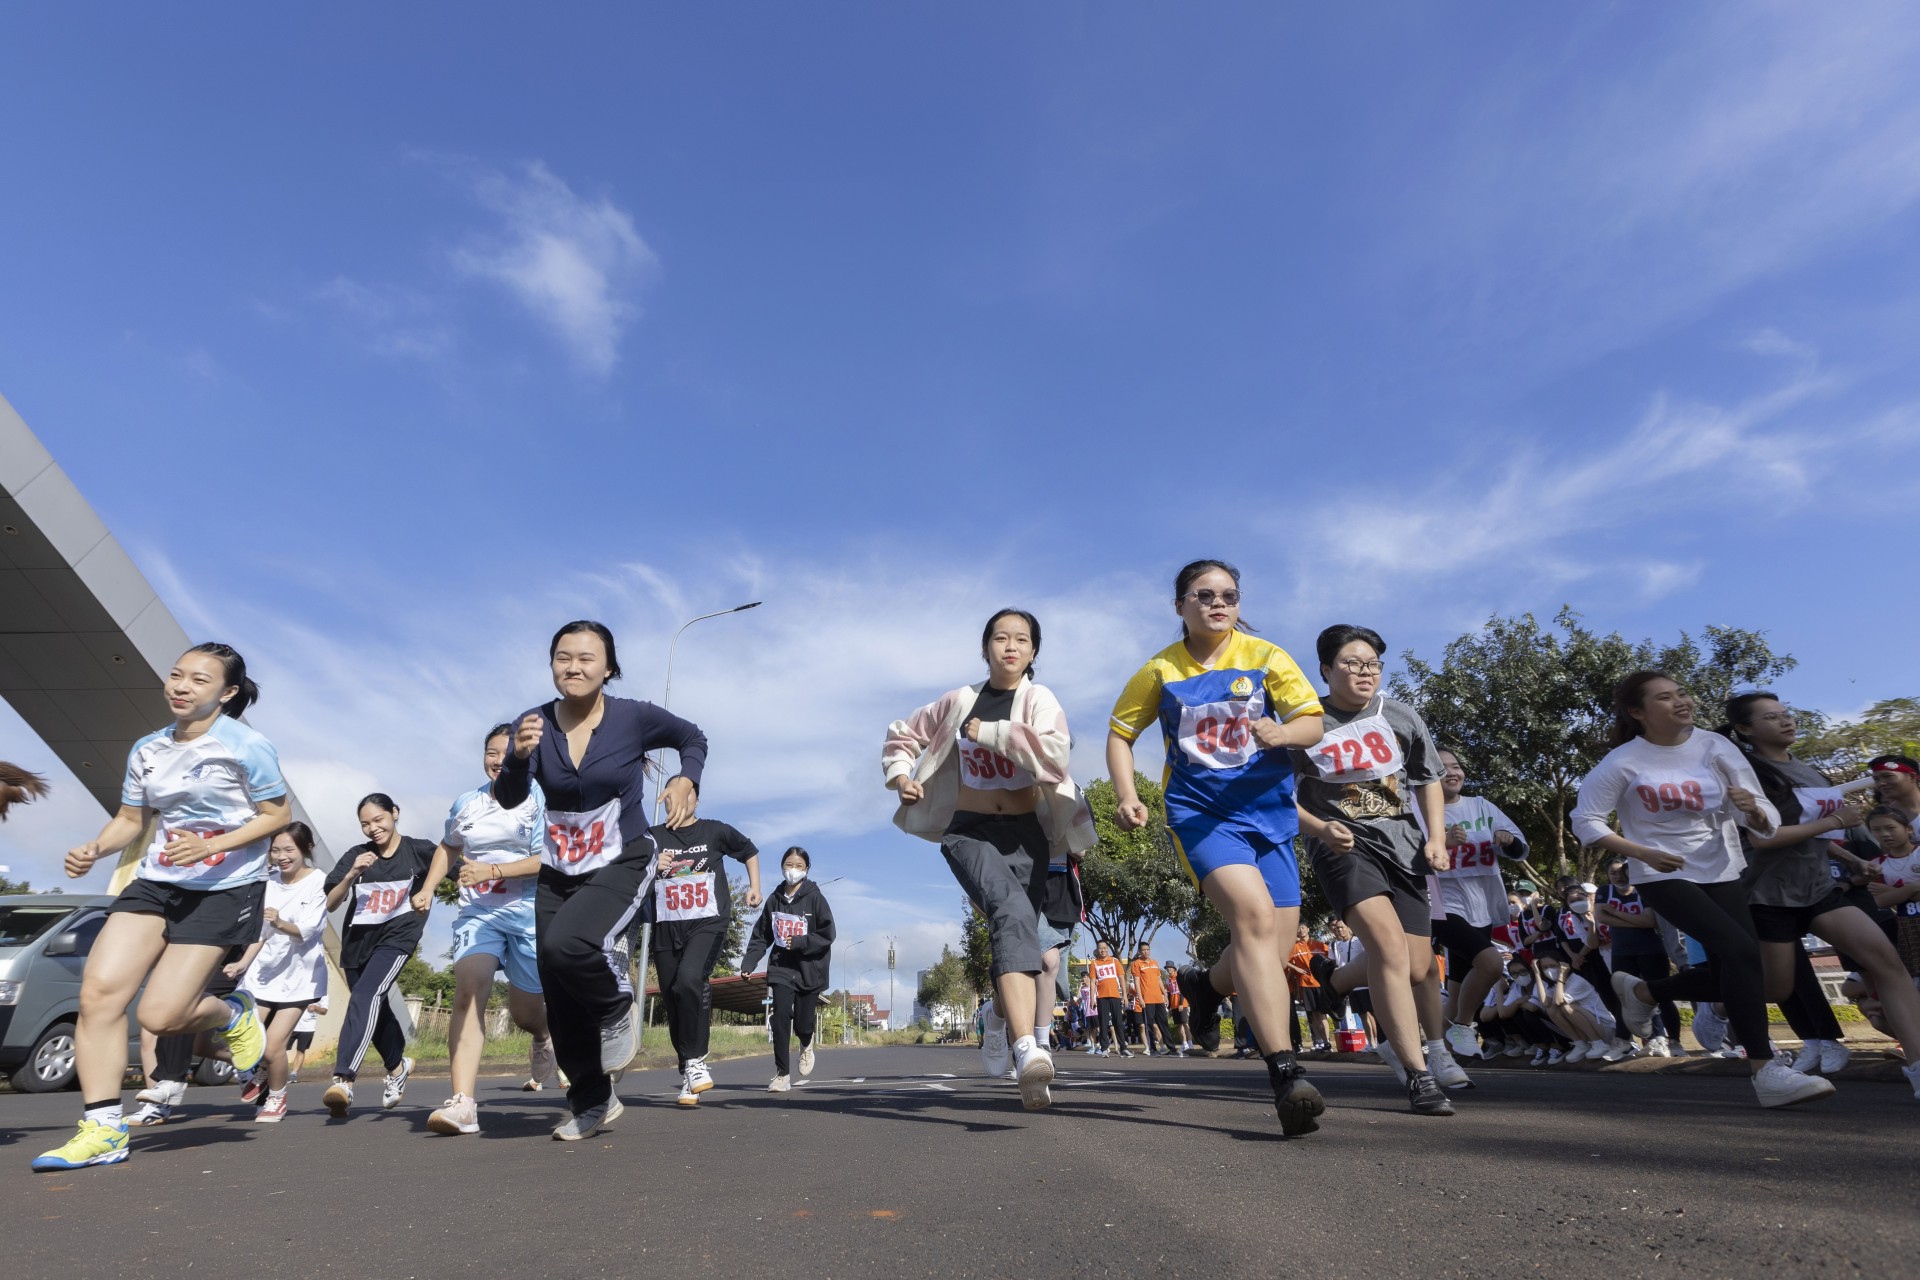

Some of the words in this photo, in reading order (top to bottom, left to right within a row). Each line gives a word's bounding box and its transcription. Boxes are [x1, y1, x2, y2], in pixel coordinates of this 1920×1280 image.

[1196, 706, 1250, 755] 945
[1319, 731, 1393, 775] 728
[1636, 780, 1704, 814] 998
[549, 820, 605, 863] 534
[1447, 841, 1495, 870] 725
[665, 882, 709, 911] 535
[1099, 965, 1116, 977] 611
